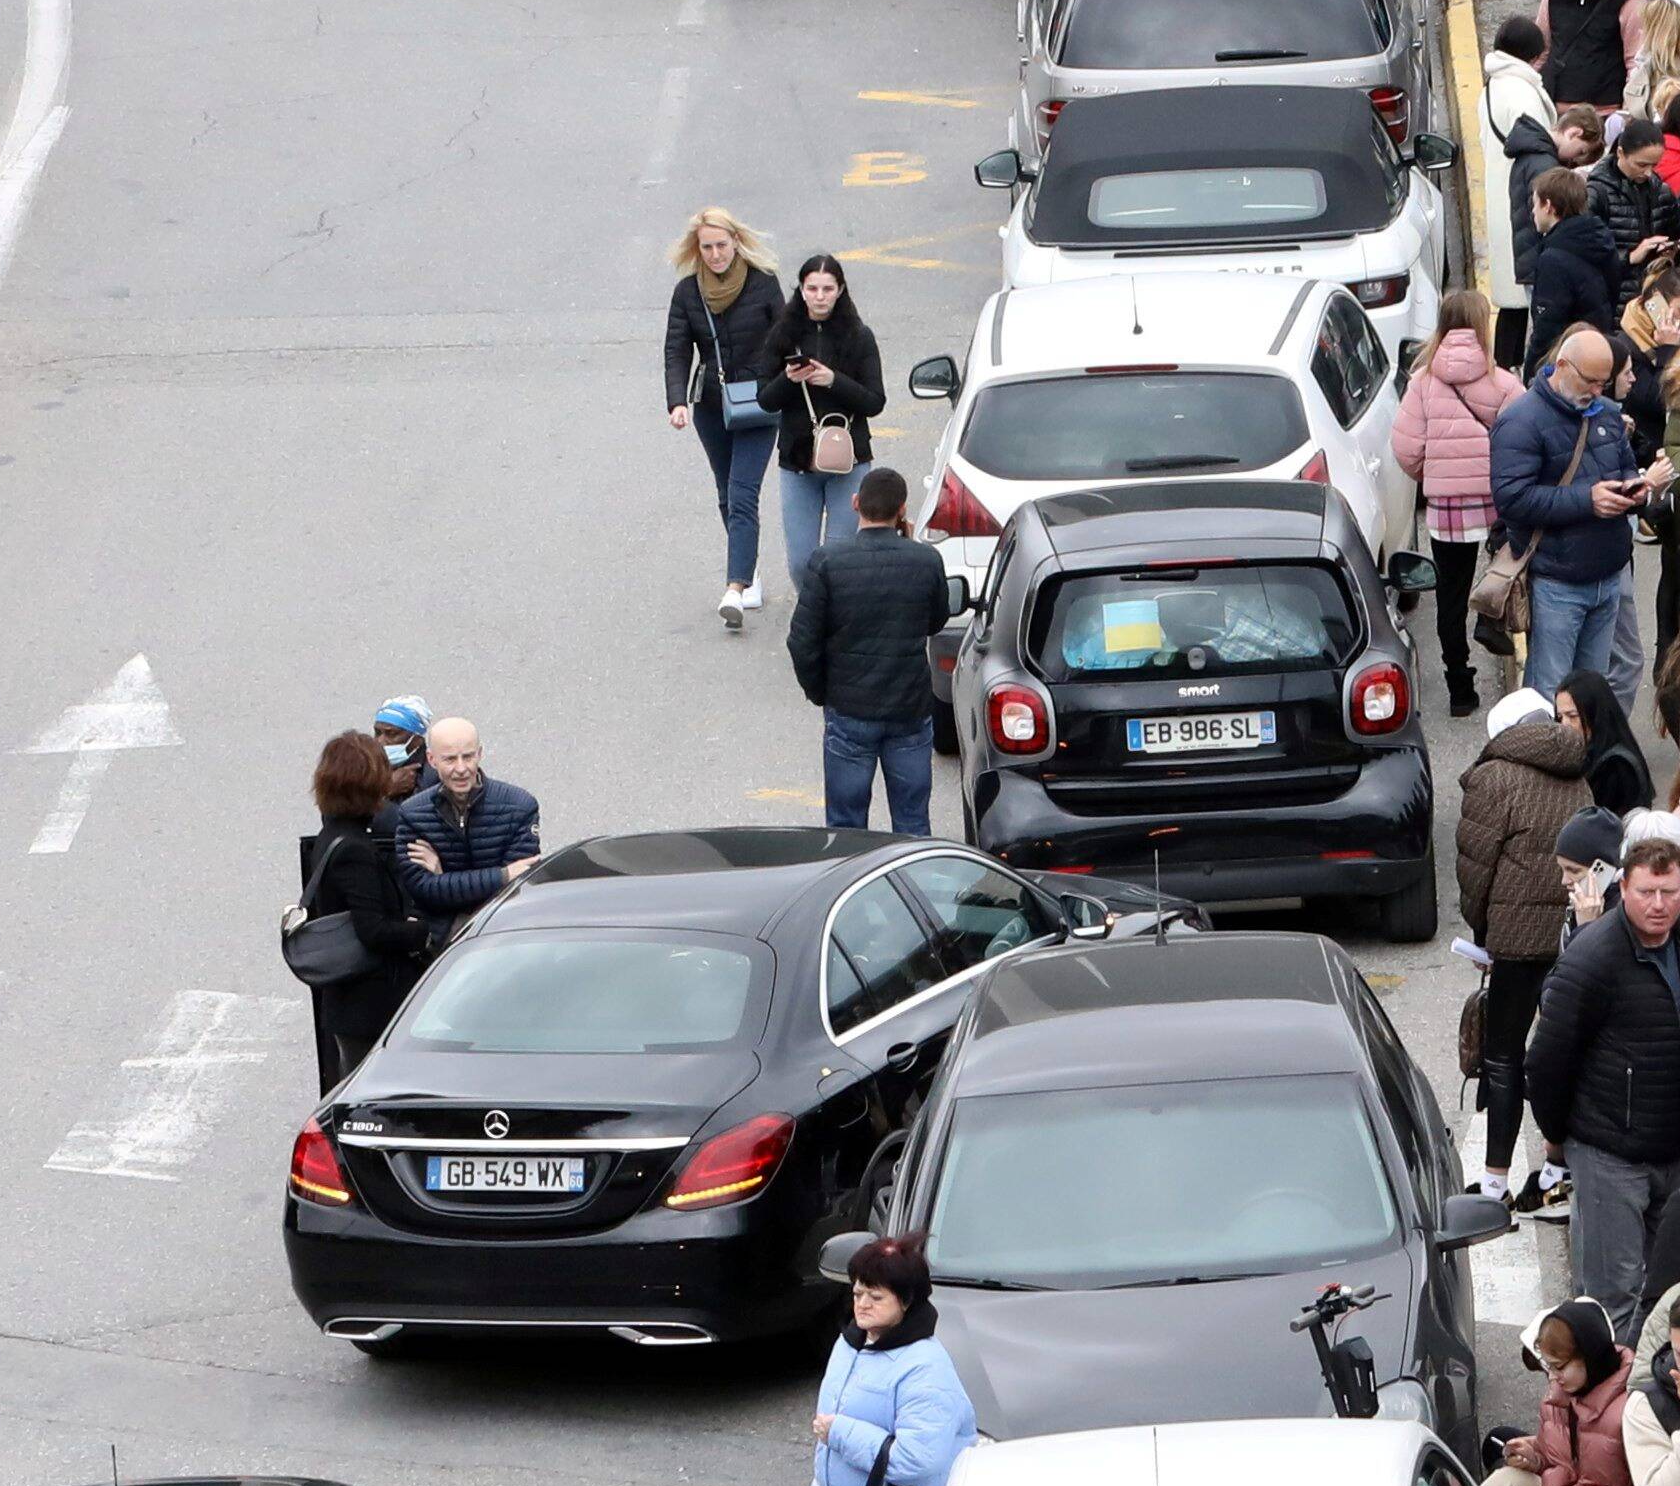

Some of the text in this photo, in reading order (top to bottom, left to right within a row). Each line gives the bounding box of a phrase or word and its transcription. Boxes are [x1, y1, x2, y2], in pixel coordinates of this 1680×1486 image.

[1178, 683, 1220, 697] smart
[1143, 718, 1259, 745] EB-986-SL
[446, 1160, 565, 1188] GB-549-WX
